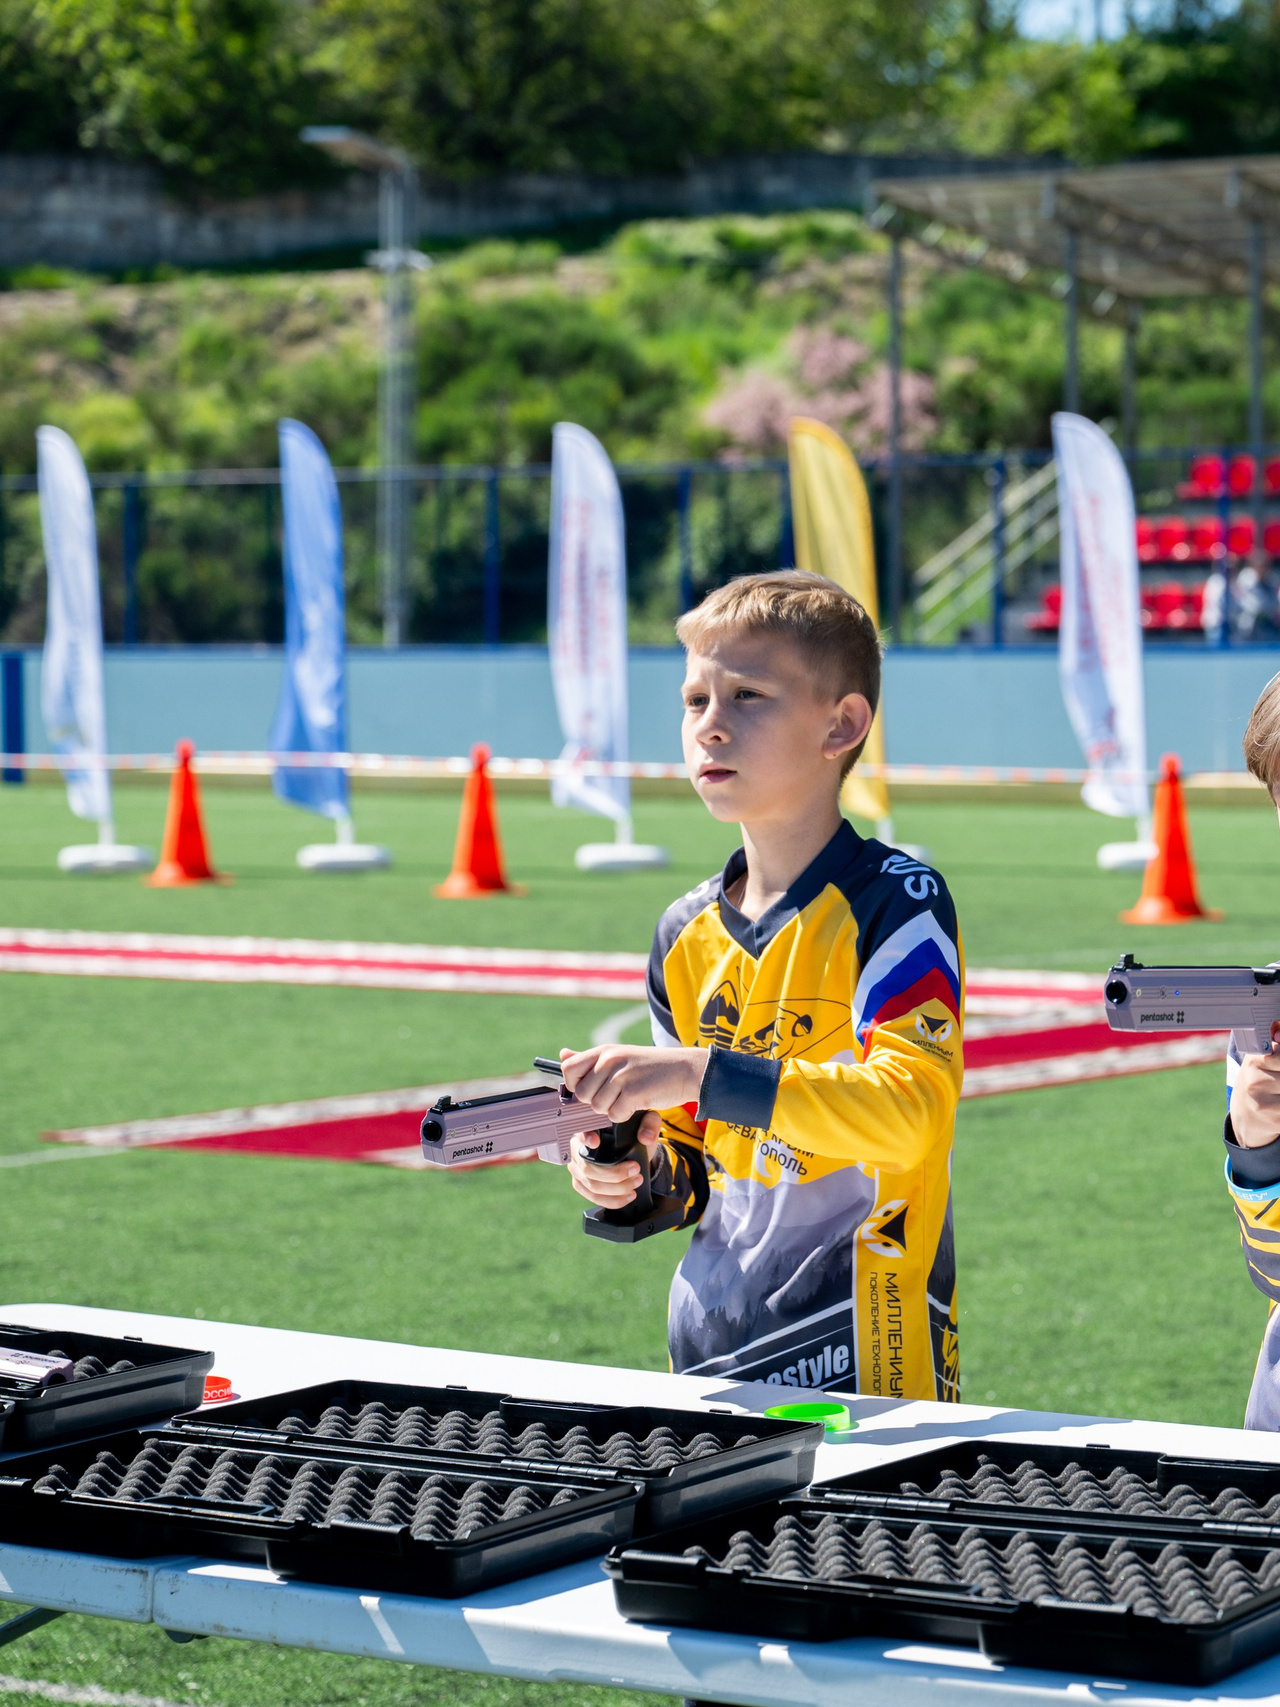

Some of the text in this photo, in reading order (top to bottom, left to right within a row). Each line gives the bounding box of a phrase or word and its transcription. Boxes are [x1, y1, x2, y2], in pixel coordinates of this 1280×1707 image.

[1140, 1012, 1174, 1023] pentashot
[452, 1144, 484, 1159] pentashot
[869, 1271, 882, 1396] ПОКОЛЕНИЕ ТЕХНОЛОГ
[753, 1344, 850, 1388] estyle
